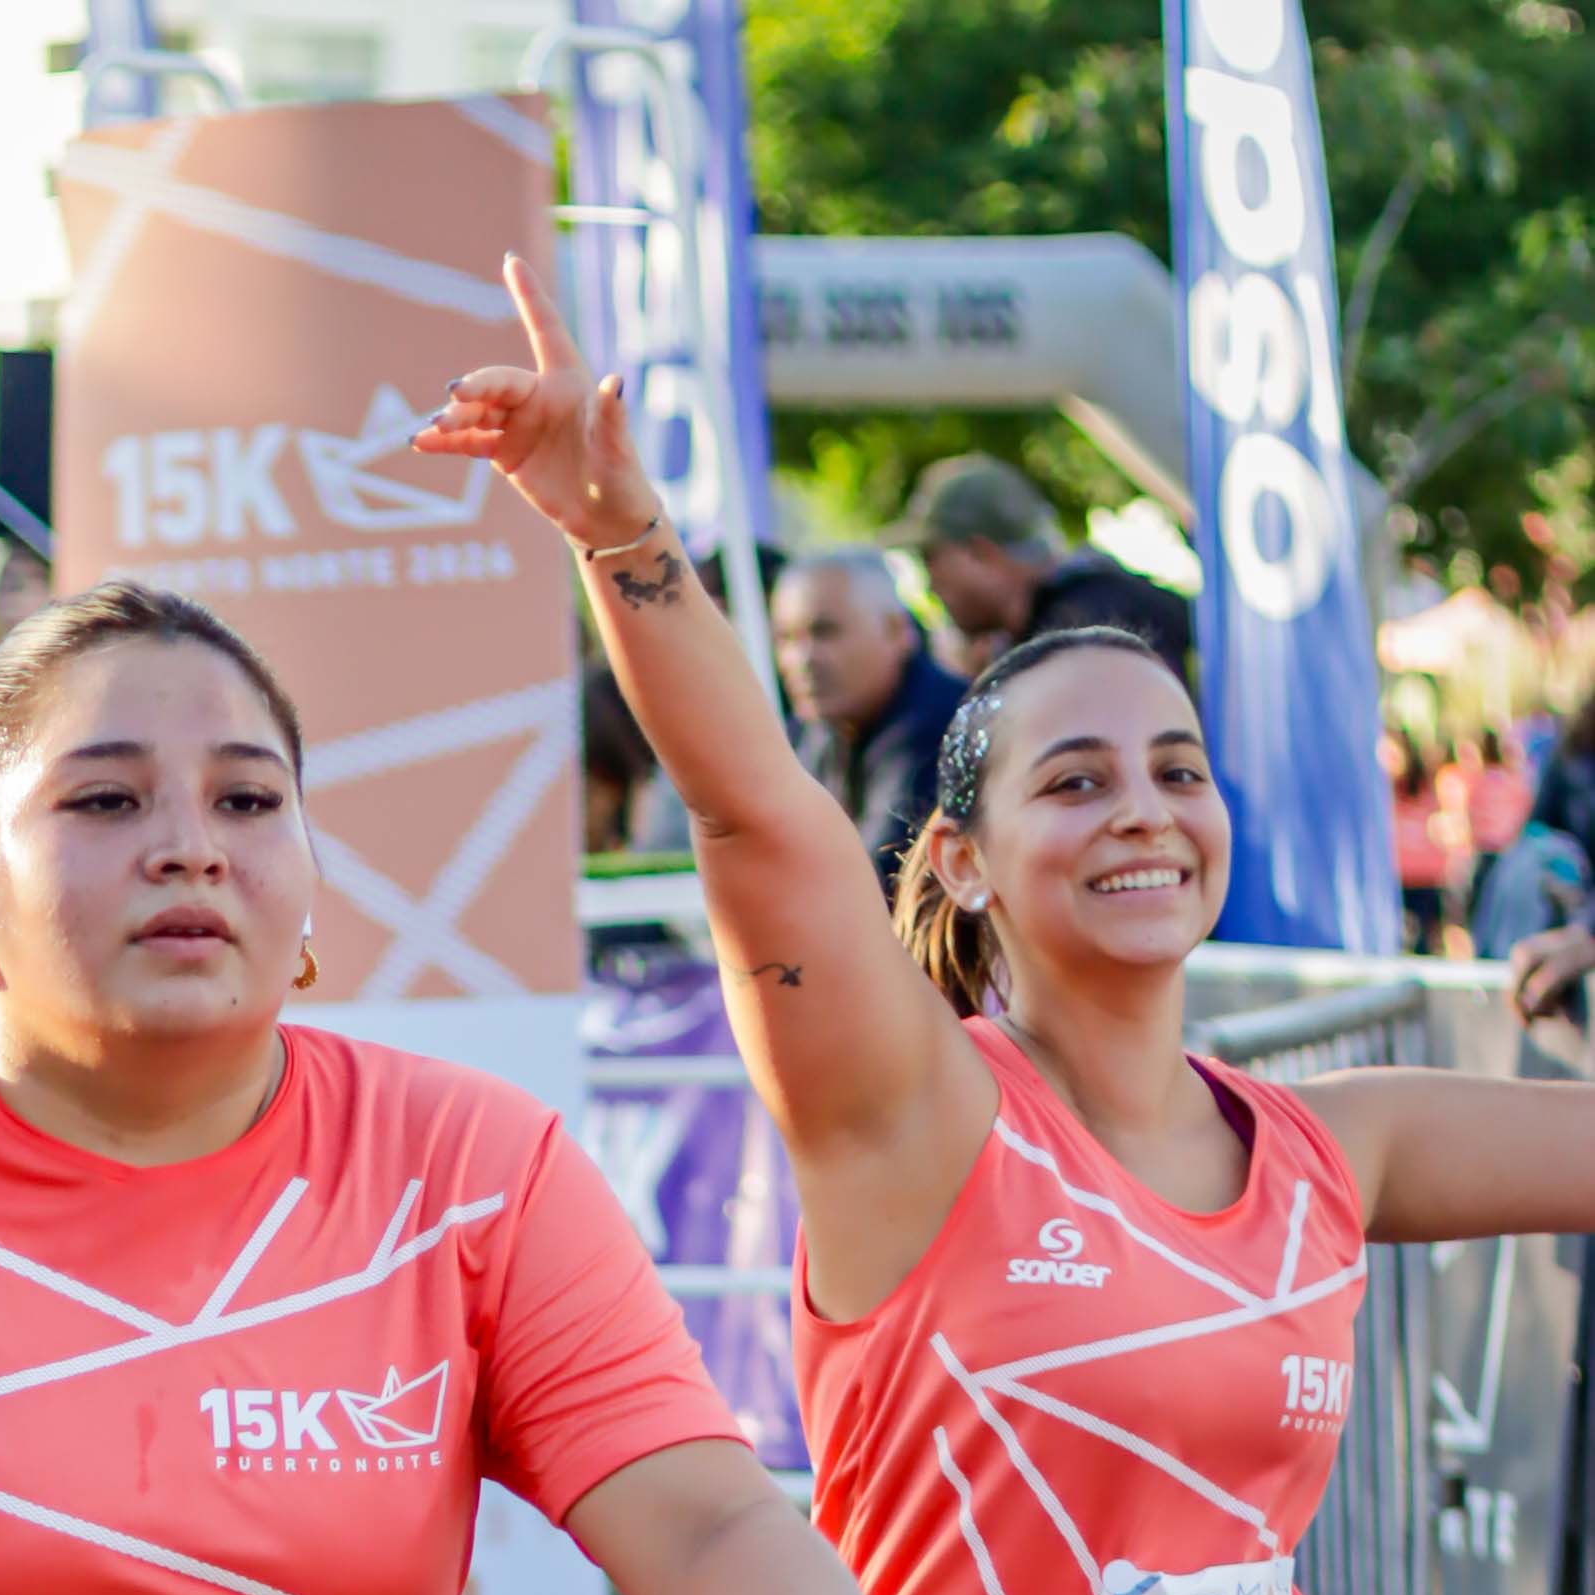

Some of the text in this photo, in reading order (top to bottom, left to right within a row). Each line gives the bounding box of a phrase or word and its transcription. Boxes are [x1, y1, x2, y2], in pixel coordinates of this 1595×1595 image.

[102, 422, 298, 547] 15K
[1280, 1354, 1347, 1416] 15K
[200, 1388, 338, 1451] 15K
[215, 1450, 443, 1473] PUERTO NORTE
